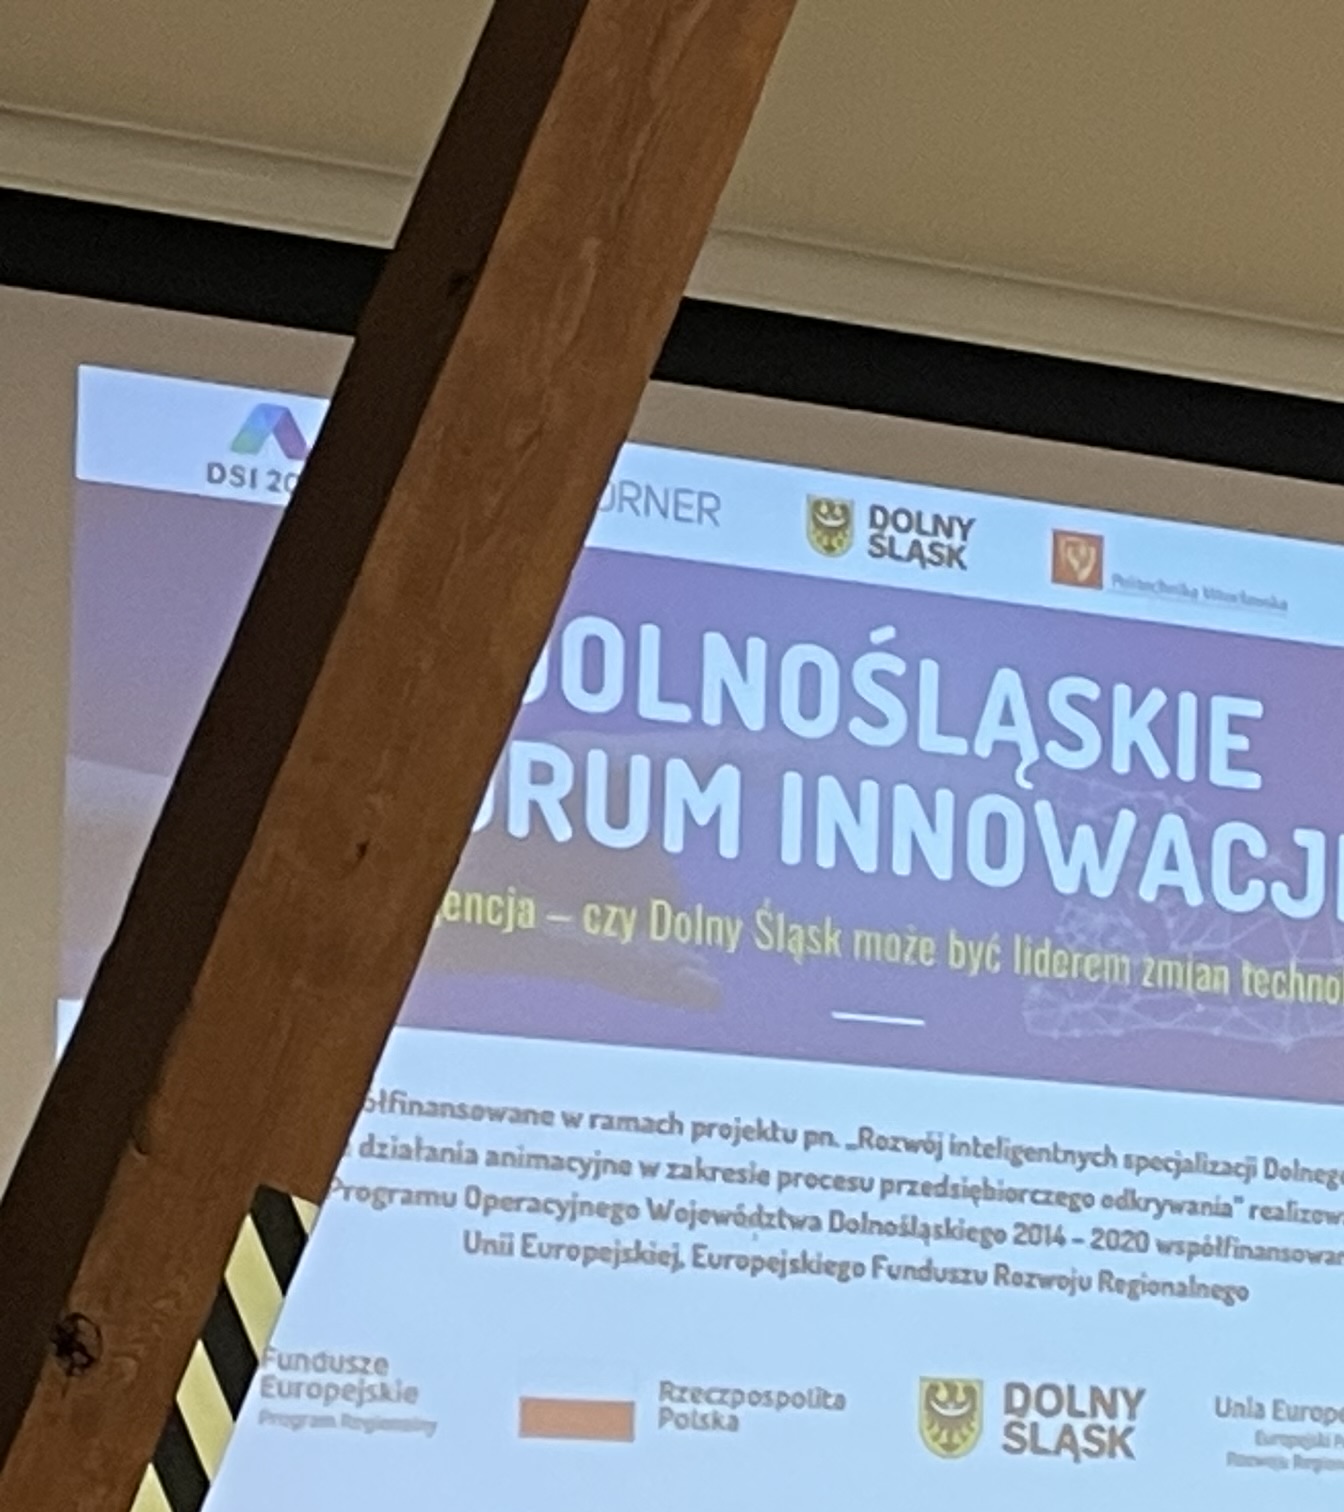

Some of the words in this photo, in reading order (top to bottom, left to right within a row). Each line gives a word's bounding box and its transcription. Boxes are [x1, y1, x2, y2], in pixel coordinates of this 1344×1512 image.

[206, 462, 257, 489] DSI
[867, 503, 976, 542] DOLNY
[867, 528, 968, 571] ŚLĄSK
[522, 614, 1265, 791] OLNOŚLĄSKIE
[472, 739, 742, 860] RUM
[582, 900, 638, 945] czy
[649, 898, 743, 953] Dolny
[755, 899, 841, 965] Śląsk
[852, 923, 936, 969] może
[948, 926, 1001, 977] być
[1014, 934, 1131, 984] liderem
[1141, 954, 1230, 996] zmian
[561, 1110, 584, 1129] w
[589, 1110, 684, 1136] ramach
[691, 1116, 798, 1147] projektu
[803, 1128, 840, 1152] pn.
[948, 1132, 1118, 1172] inteligentnych
[1123, 1149, 1258, 1185] specjalizacji
[358, 1132, 479, 1166] działania
[485, 1144, 632, 1181] animacyjne
[638, 1159, 661, 1179] w
[666, 1156, 770, 1187] zakresie
[776, 1168, 874, 1193] procesu
[879, 1172, 1096, 1213] przedsiębiorczego
[464, 1184, 641, 1225] Operacyjnego
[645, 1197, 823, 1232] Województwa
[827, 1209, 1008, 1249] Dolnośląskiego
[1012, 1221, 1066, 1247] 2014
[1089, 1227, 1150, 1254] 2020
[462, 1229, 515, 1257] Unii
[520, 1232, 685, 1274] Europejskiej,
[692, 1243, 867, 1283] Europejskiego
[871, 1254, 988, 1287] Funduszu
[993, 1262, 1093, 1297] Rozwoju
[1098, 1268, 1249, 1307] Regionalnego
[259, 1373, 420, 1408] Europejskie
[658, 1378, 847, 1414] Rzeczpospolita
[1003, 1380, 1146, 1422] DOLNY
[1214, 1394, 1266, 1420] Unia
[658, 1406, 740, 1433] Polska
[1002, 1415, 1136, 1463] ŚLĄSK
